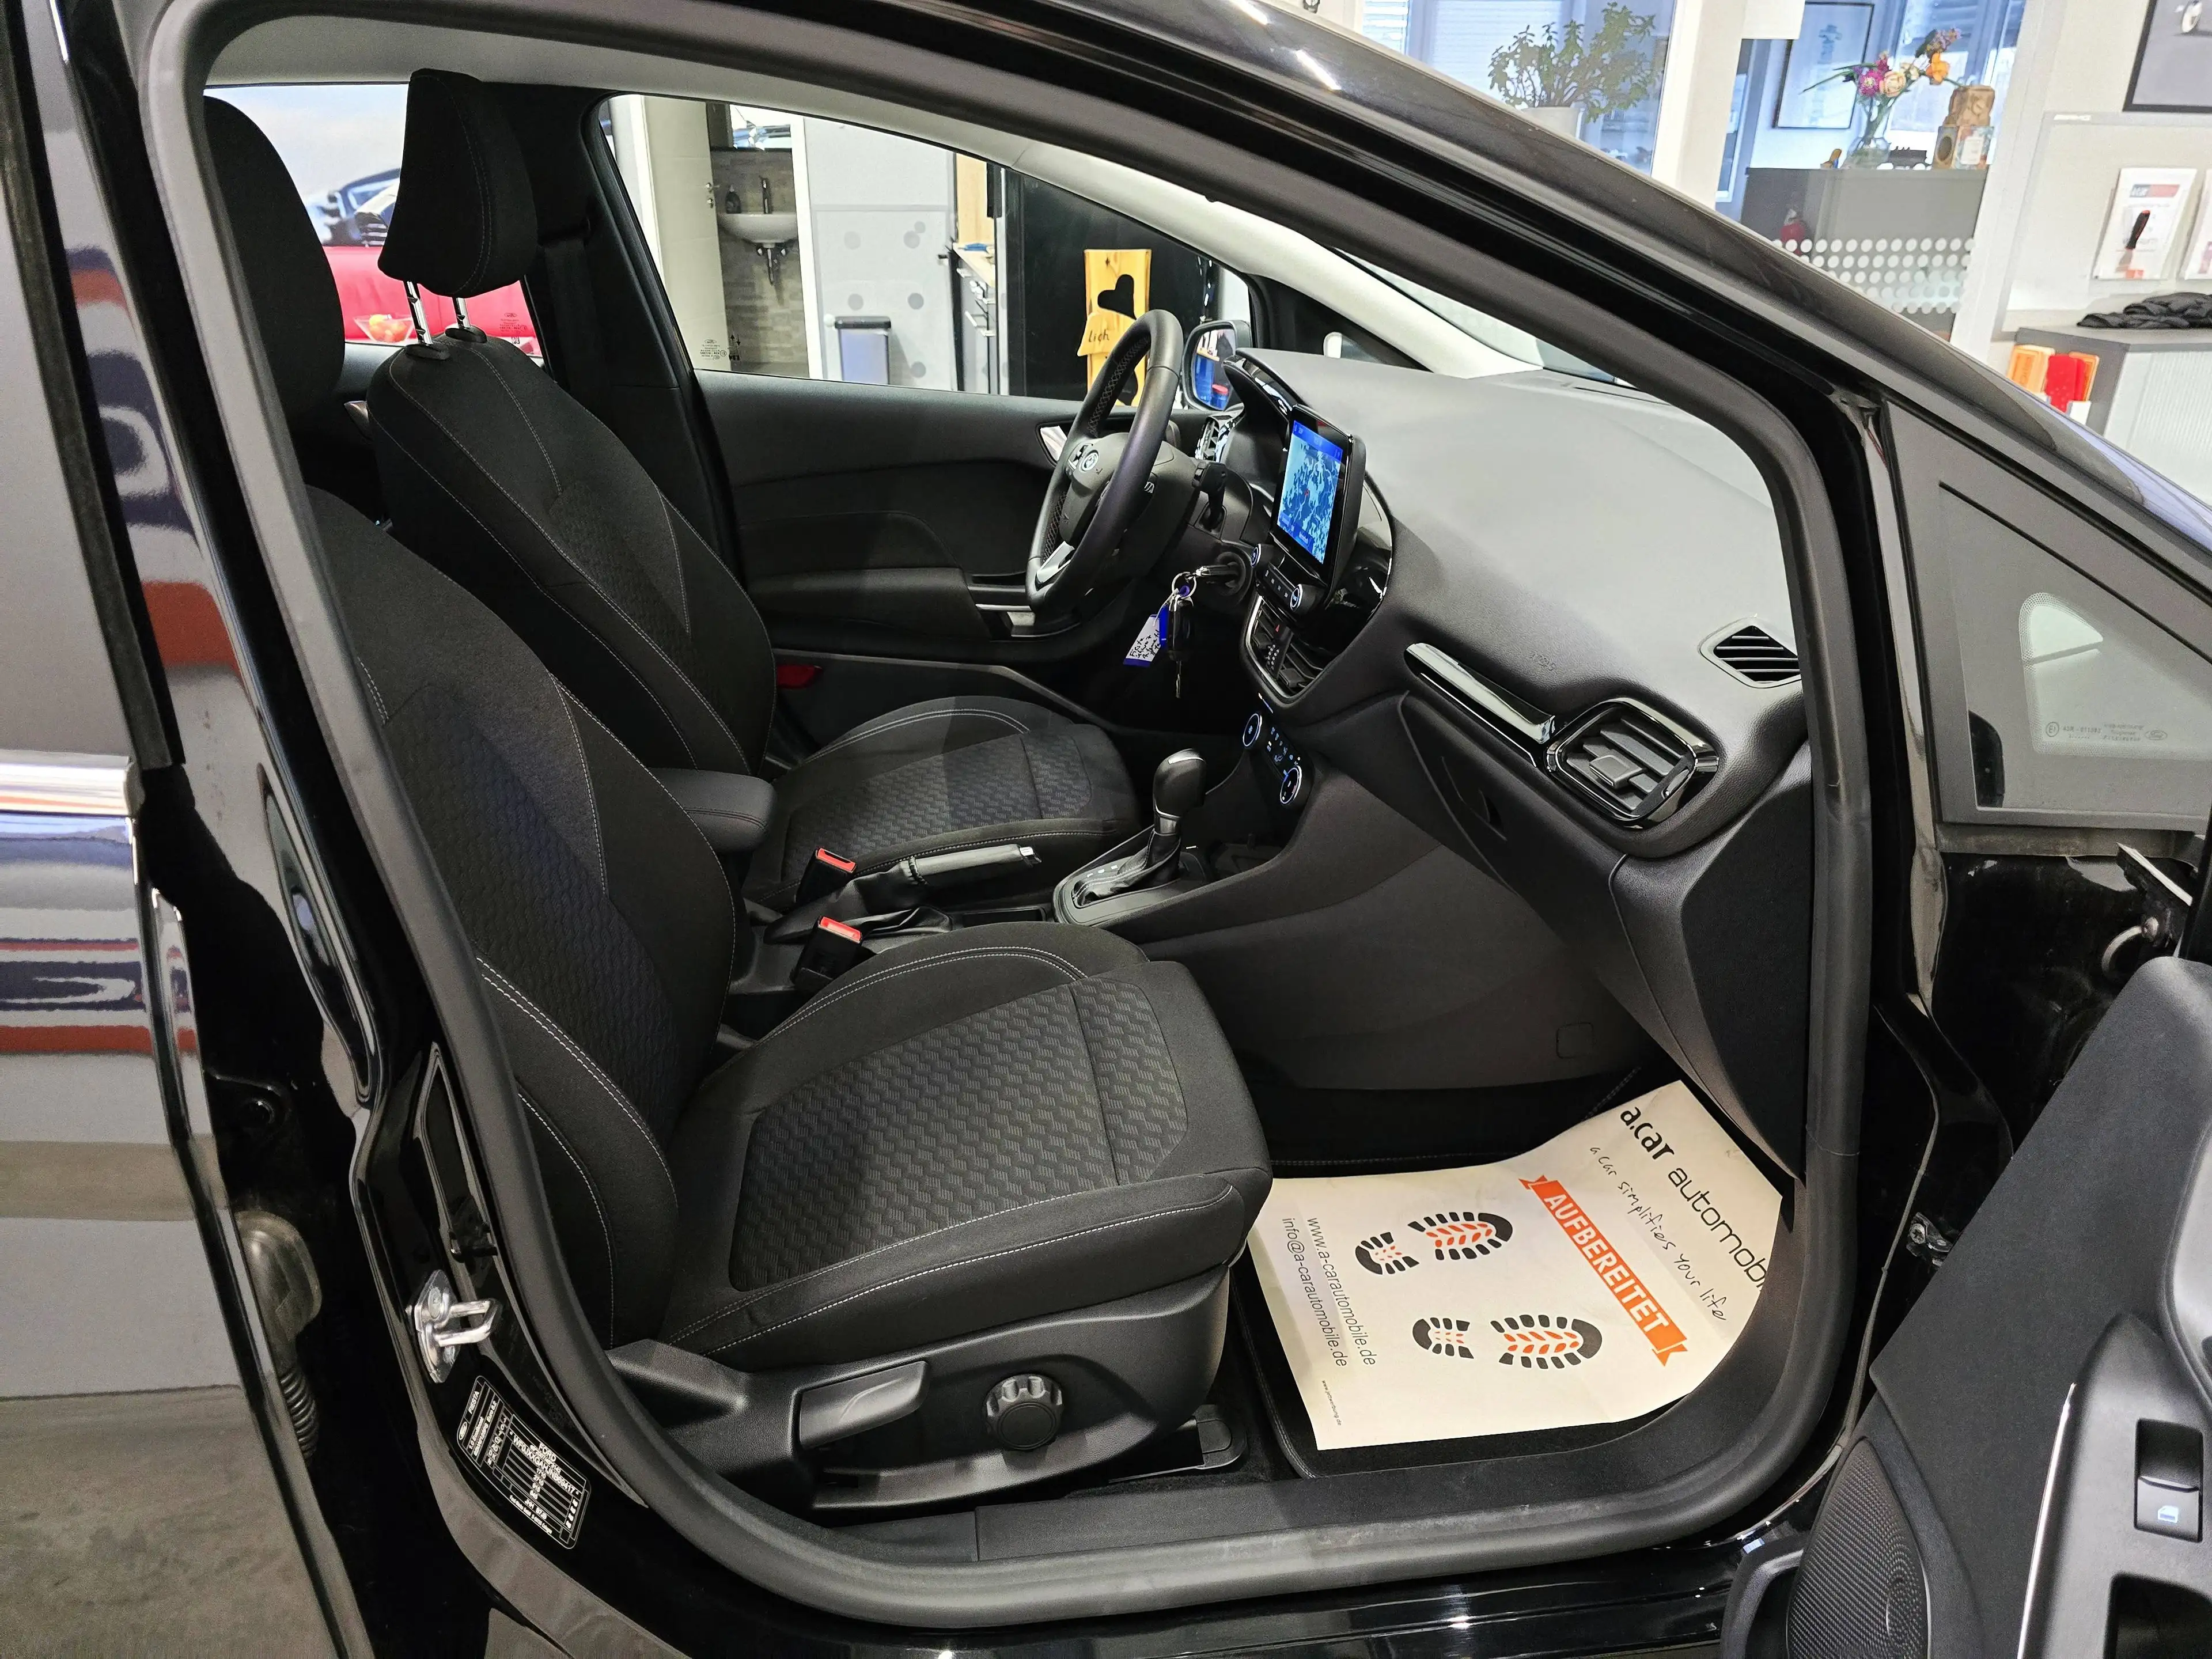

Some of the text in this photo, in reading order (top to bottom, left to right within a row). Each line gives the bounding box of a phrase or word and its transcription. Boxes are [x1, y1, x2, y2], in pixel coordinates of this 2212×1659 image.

[1620, 1107, 1675, 1160] a.car
[1282, 1218, 1348, 1366] info@a-carautomobile.de
[1307, 1217, 1377, 1366] www.a-carautomobile.de
[1544, 1194, 1669, 1332] AUFBEREITET
[1598, 1156, 1617, 1176] car
[1618, 1181, 1676, 1250] simplifies
[1699, 1288, 1727, 1320] life
[468, 1391, 479, 1414] FIESTA
[539, 1442, 556, 1463] FORD
